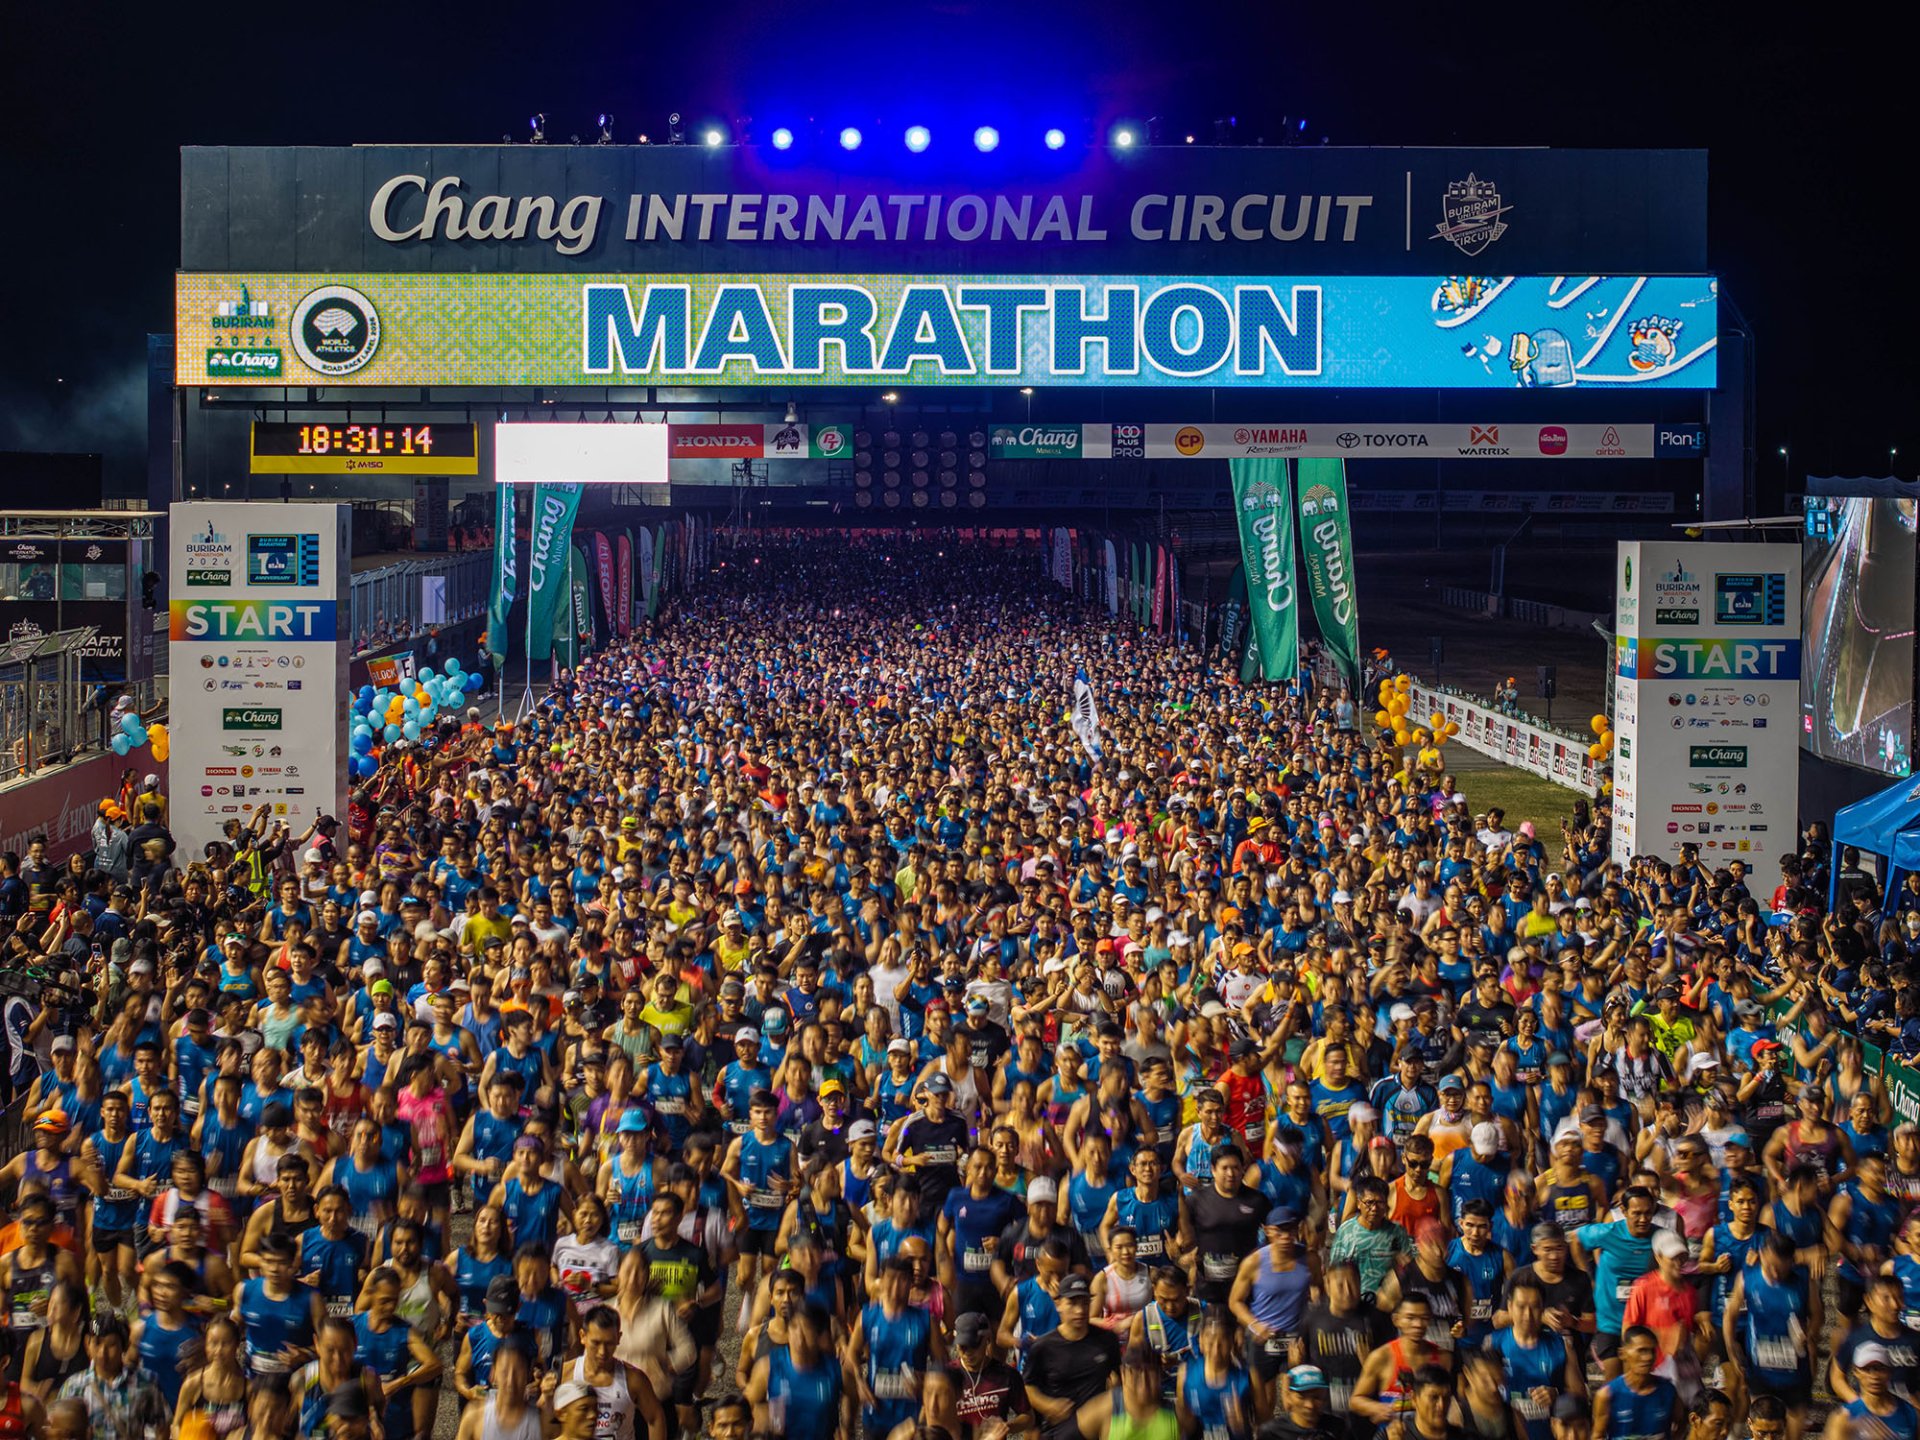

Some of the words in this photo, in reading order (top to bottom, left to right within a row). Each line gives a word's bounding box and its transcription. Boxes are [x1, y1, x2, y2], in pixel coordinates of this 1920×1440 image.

[1448, 198, 1497, 218] BURIRAM
[1458, 209, 1487, 220] UNITED
[370, 174, 602, 256] Chang
[625, 193, 1108, 242] INTERNATIONAL
[1131, 193, 1373, 242] CIRCUIT
[211, 316, 275, 329] BURIRAM
[583, 283, 1323, 377] MARATHON
[214, 336, 273, 346] 2026
[322, 338, 351, 346] WORLD
[315, 345, 356, 353] ATHLETICS
[231, 351, 279, 370] Chang
[1018, 427, 1079, 449] Chang
[1116, 425, 1141, 438] 100
[1251, 429, 1308, 444] YAMAHA
[298, 425, 433, 454] 18:31:14
[676, 436, 757, 448] HONDA
[1178, 435, 1200, 447] CP
[1363, 434, 1429, 447] TOYOTA
[1112, 447, 1143, 458] PRO
[1457, 448, 1510, 456] WARRIX
[1595, 447, 1626, 456] airbnb
[532, 496, 567, 592] Chang
[551, 525, 568, 566] MINERAL
[188, 558, 230, 566] 2026
[201, 571, 230, 582] Chang
[1656, 583, 1700, 591] BURIRAM
[185, 605, 321, 636] START
[1670, 610, 1697, 621] Chang
[1222, 610, 1238, 651] Chang
[84, 636, 122, 647] ART
[1617, 646, 1637, 669] START
[1654, 643, 1786, 674] START
[242, 711, 279, 724] Chang
[1529, 745, 1539, 765] GR
[1709, 748, 1744, 762] Chang
[1553, 755, 1564, 775] GR
[1581, 766, 1593, 787] GR
[1894, 1080, 1920, 1126] Chang
[1135, 1243, 1157, 1254] 4331
